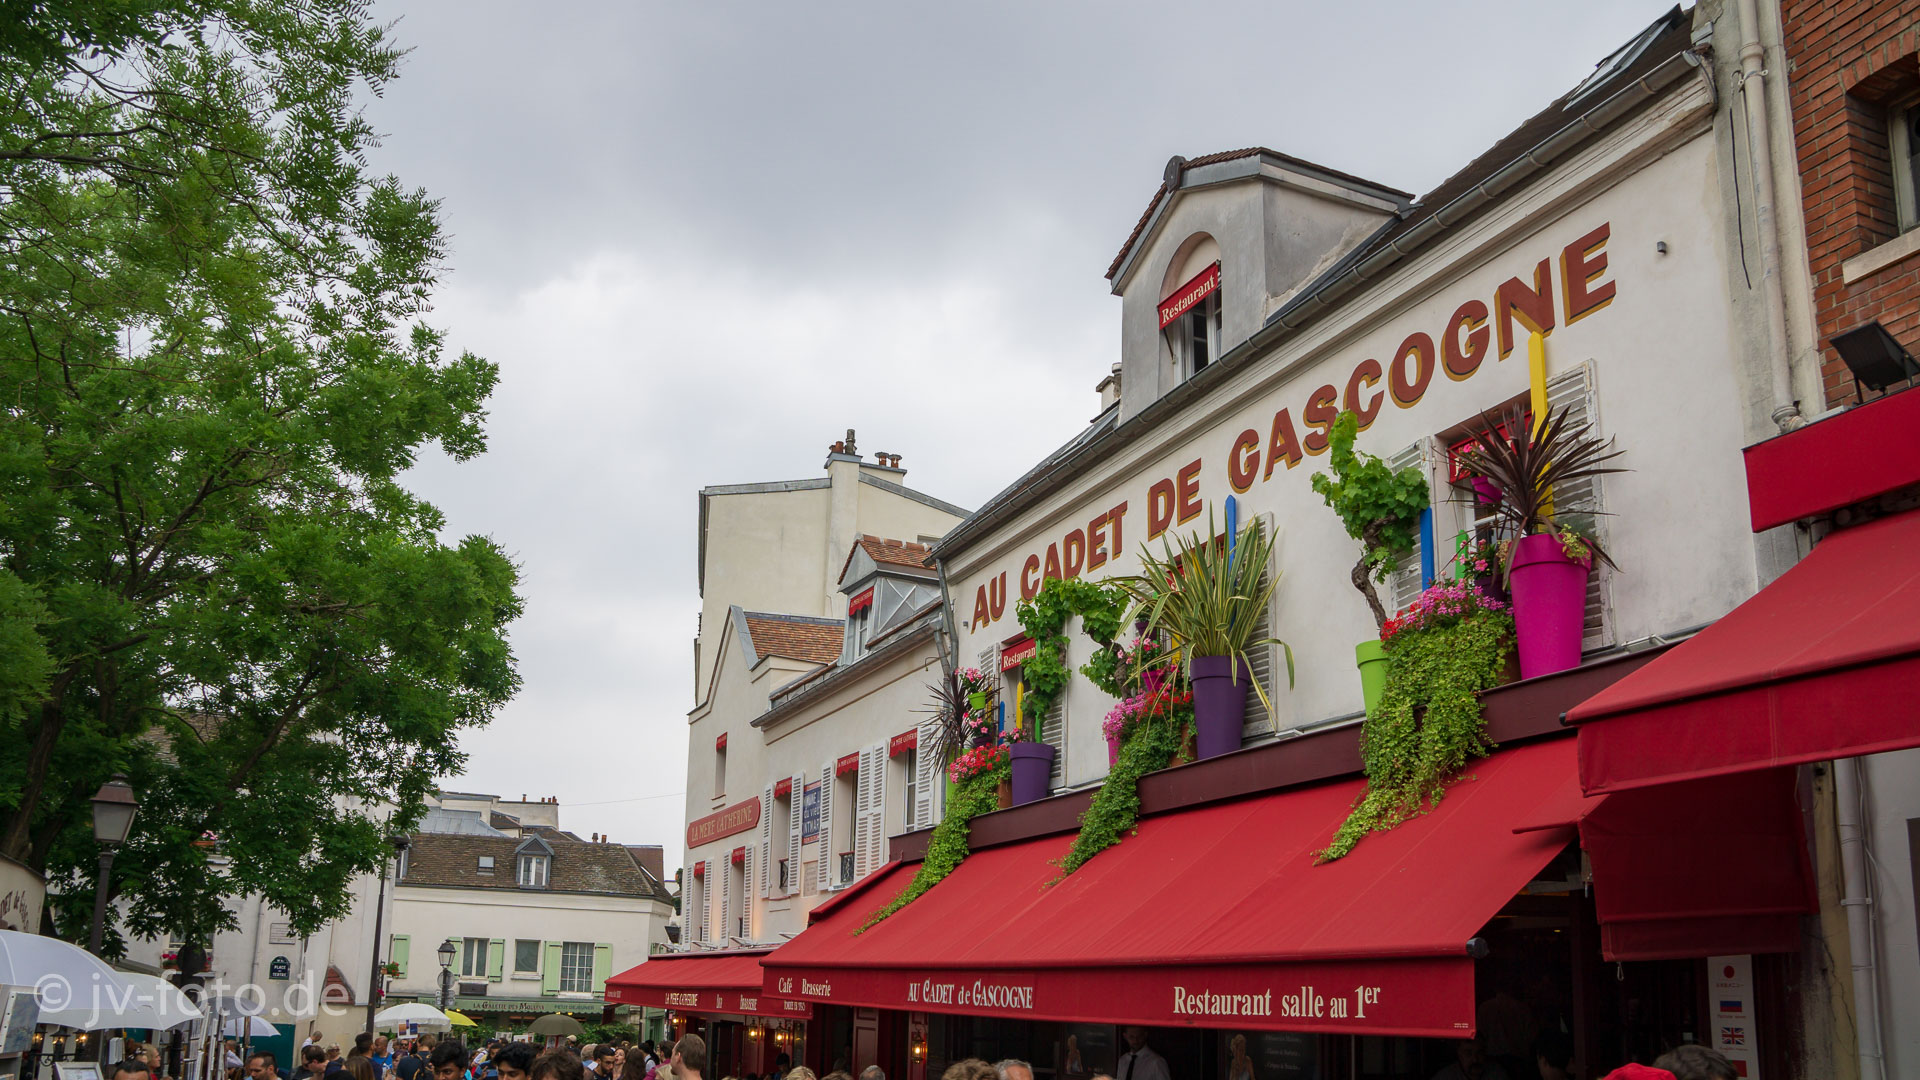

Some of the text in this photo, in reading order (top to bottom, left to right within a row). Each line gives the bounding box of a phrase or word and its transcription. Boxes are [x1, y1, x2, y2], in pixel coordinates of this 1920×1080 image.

[1161, 274, 1215, 325] Restaurant
[970, 570, 1007, 635] AU
[1020, 500, 1128, 605] CADET
[1147, 457, 1203, 542] DE
[1227, 221, 1617, 494] GASCOGNE
[1003, 647, 1036, 669] Restauran
[691, 826, 699, 842] LA
[716, 804, 753, 833] CATHERINE
[778, 977, 831, 997] Café Brasserie
[907, 977, 1033, 1009] AU CADET de GASCOGNE
[1172, 985, 1381, 1018] Restaurant salle au 1er
